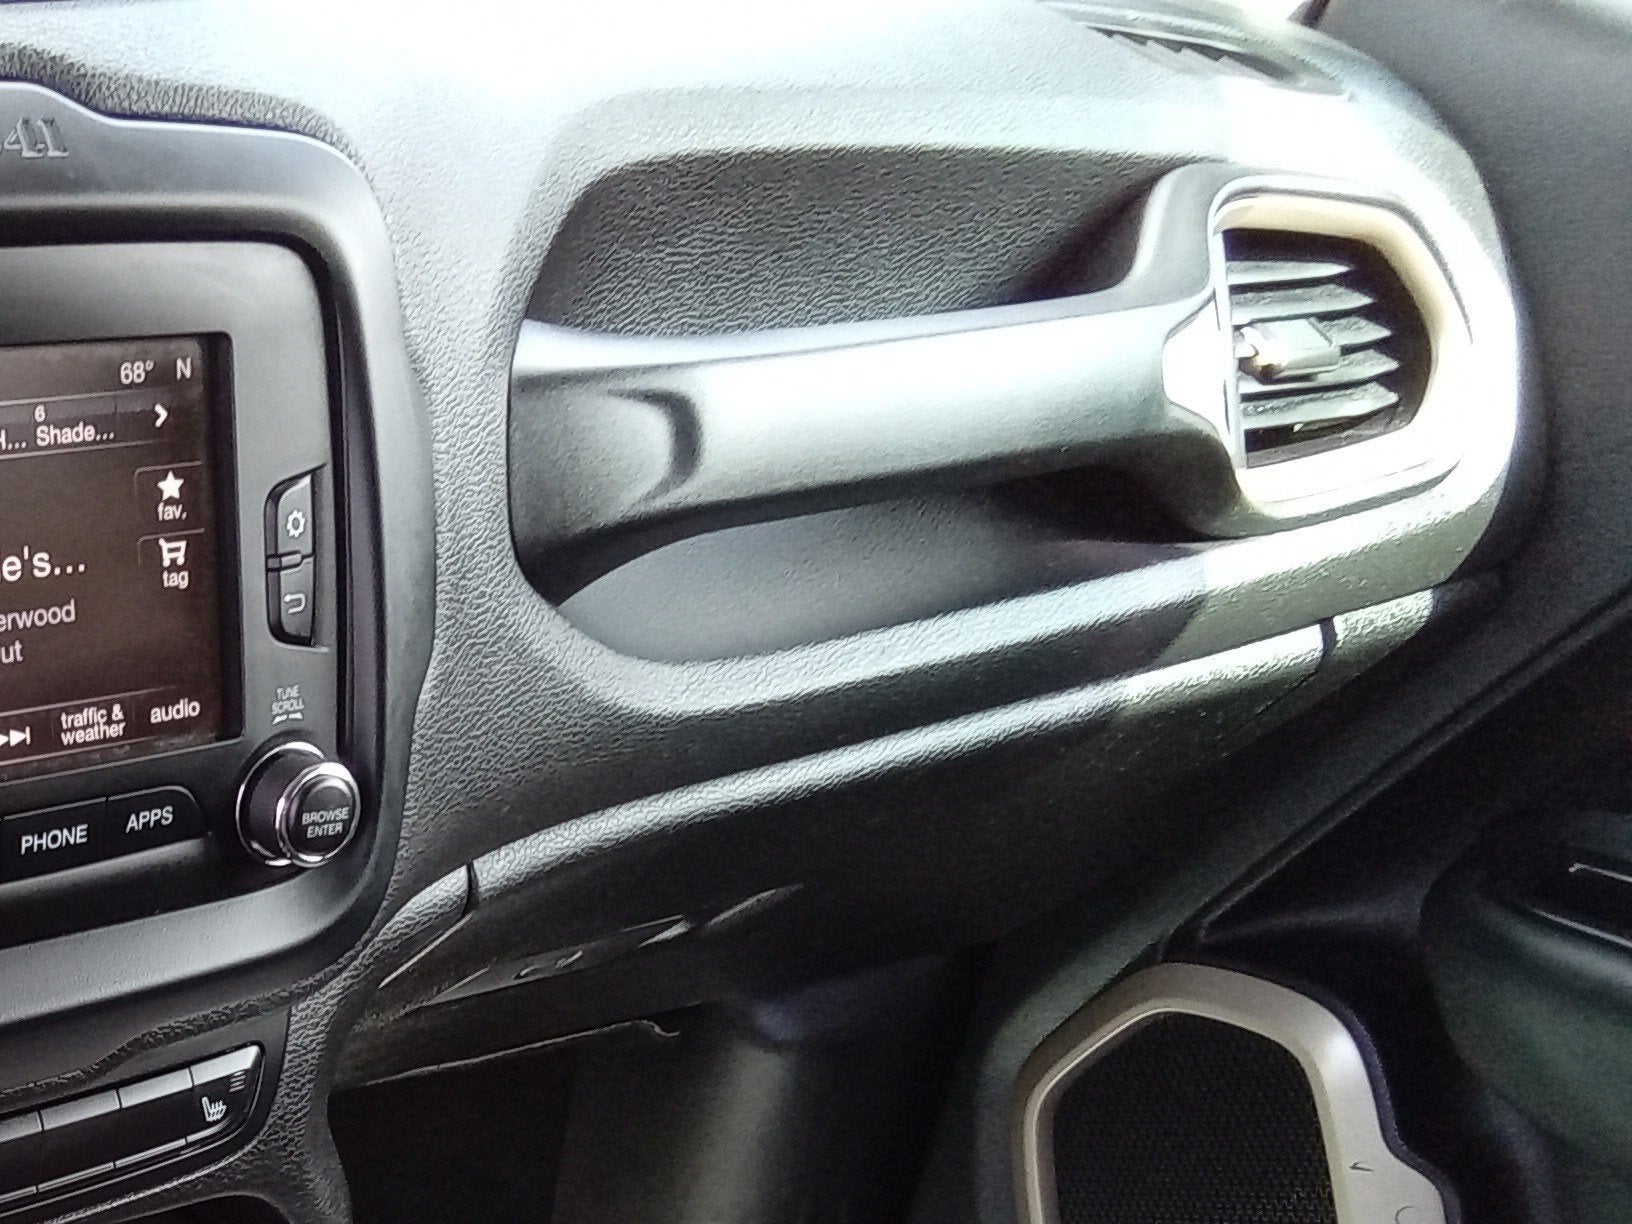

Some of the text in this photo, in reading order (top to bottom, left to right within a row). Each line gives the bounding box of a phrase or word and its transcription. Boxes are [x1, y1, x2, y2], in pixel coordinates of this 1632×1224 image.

[176, 357, 192, 380] N
[34, 404, 46, 422] 6
[162, 569, 189, 590] tag
[61, 703, 124, 730] traffic &
[150, 698, 201, 725] audio
[61, 721, 126, 747] weather
[126, 806, 174, 834] APPS
[302, 806, 349, 824] BROWSE
[20, 824, 88, 855] PHONE
[306, 823, 344, 839] ENTER
